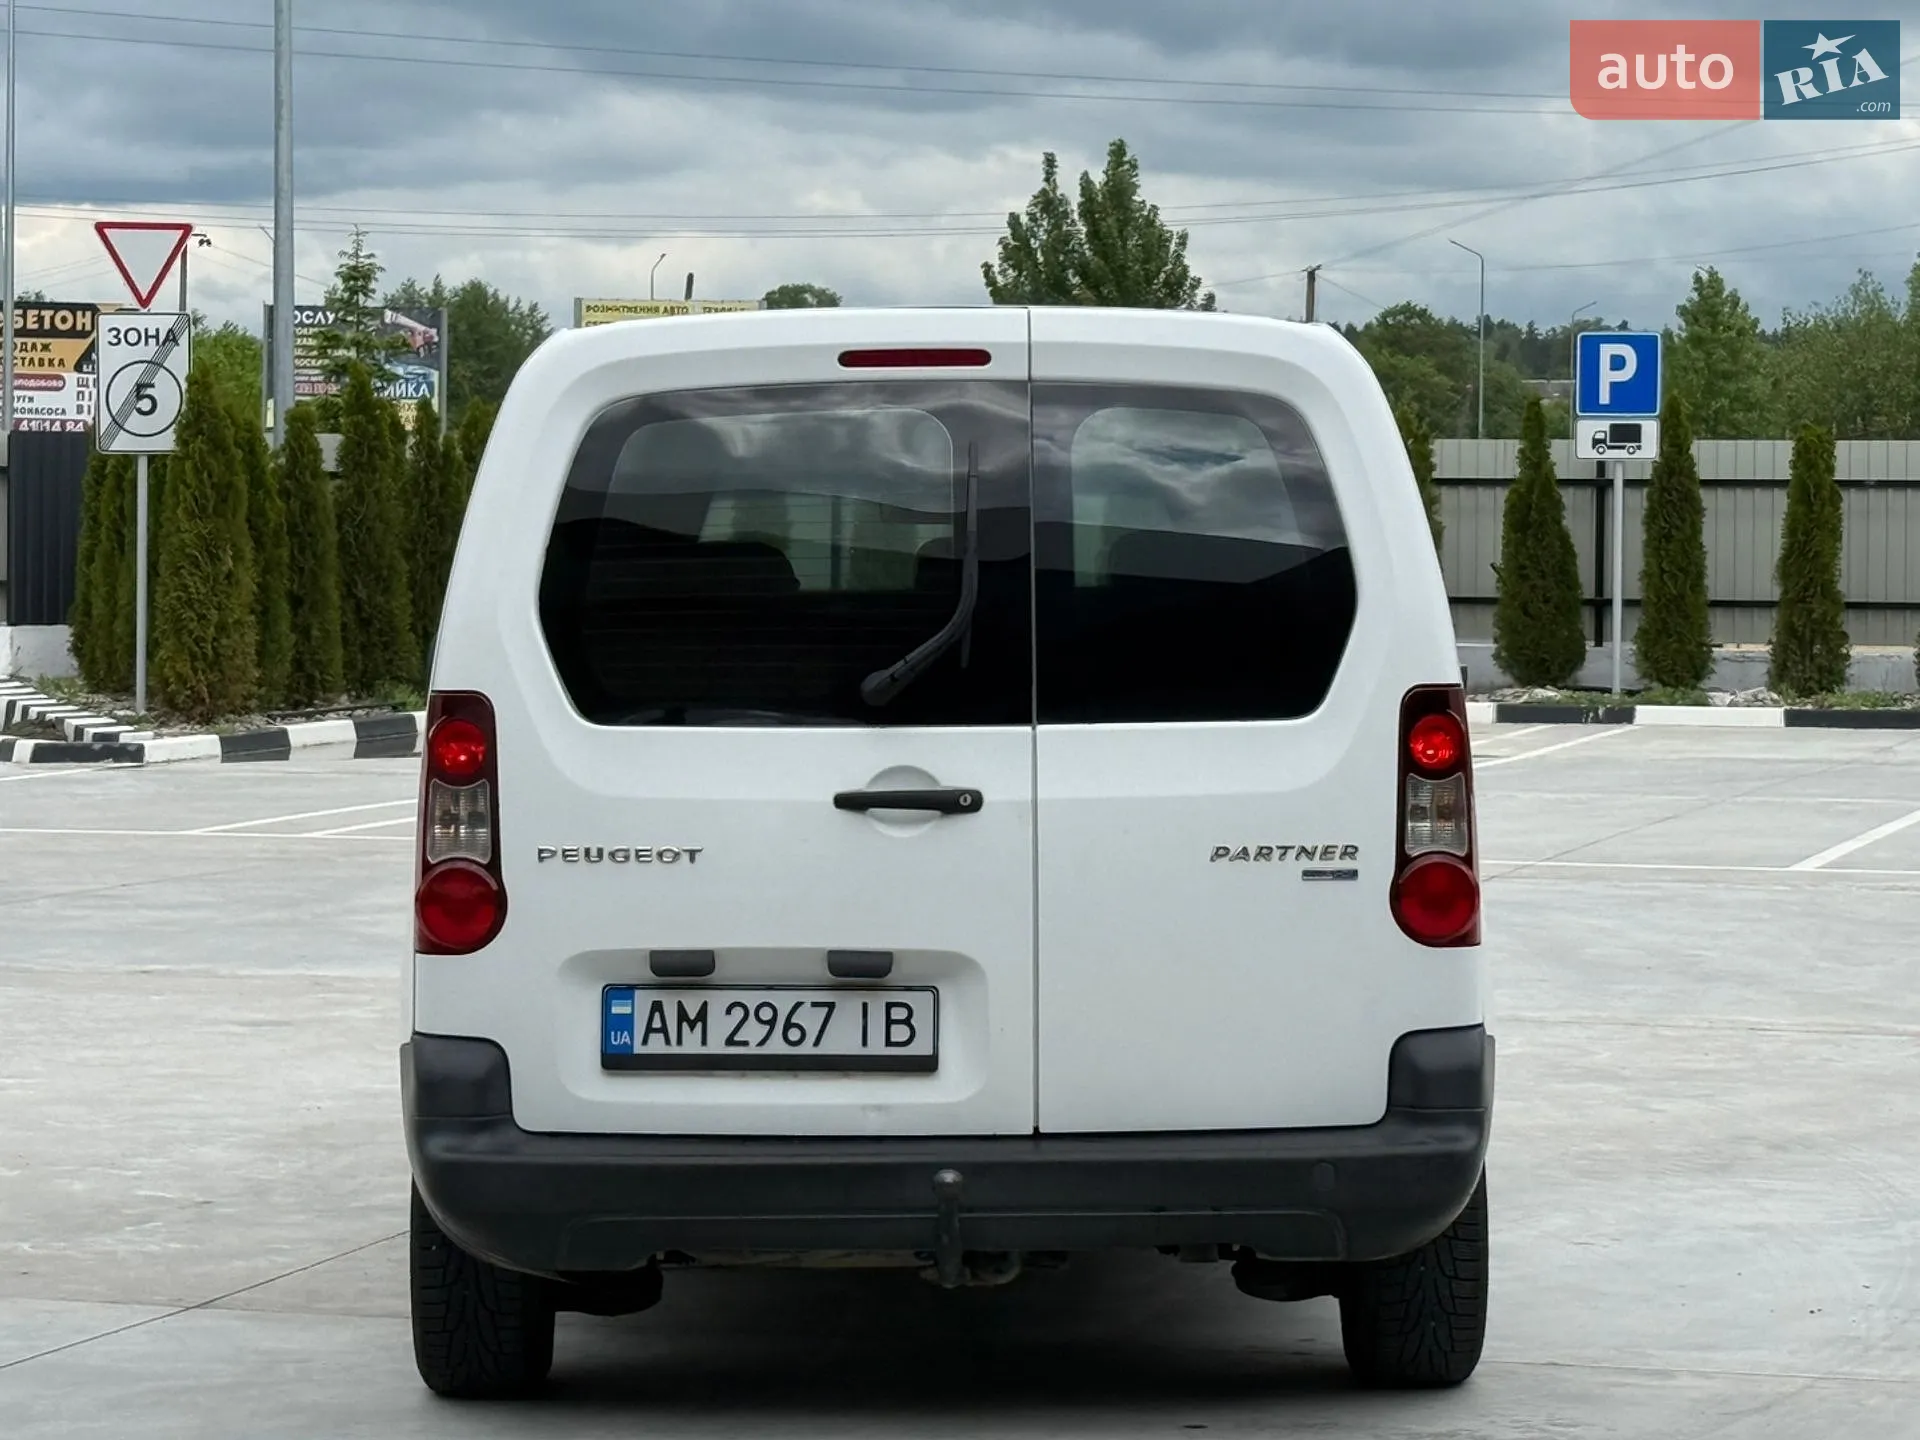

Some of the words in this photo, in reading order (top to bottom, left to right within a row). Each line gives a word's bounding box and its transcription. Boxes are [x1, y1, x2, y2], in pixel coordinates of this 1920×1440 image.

[0, 309, 92, 331] БЕТОН
[107, 327, 180, 347] ЗОНА
[1599, 343, 1638, 405] P
[134, 382, 158, 416] 5
[537, 846, 703, 863] PEUGEOT
[1209, 845, 1360, 862] PARTNER
[641, 1000, 708, 1047] AM
[724, 1001, 836, 1048] 2967
[861, 1001, 917, 1048] IB
[610, 1031, 632, 1046] UA
